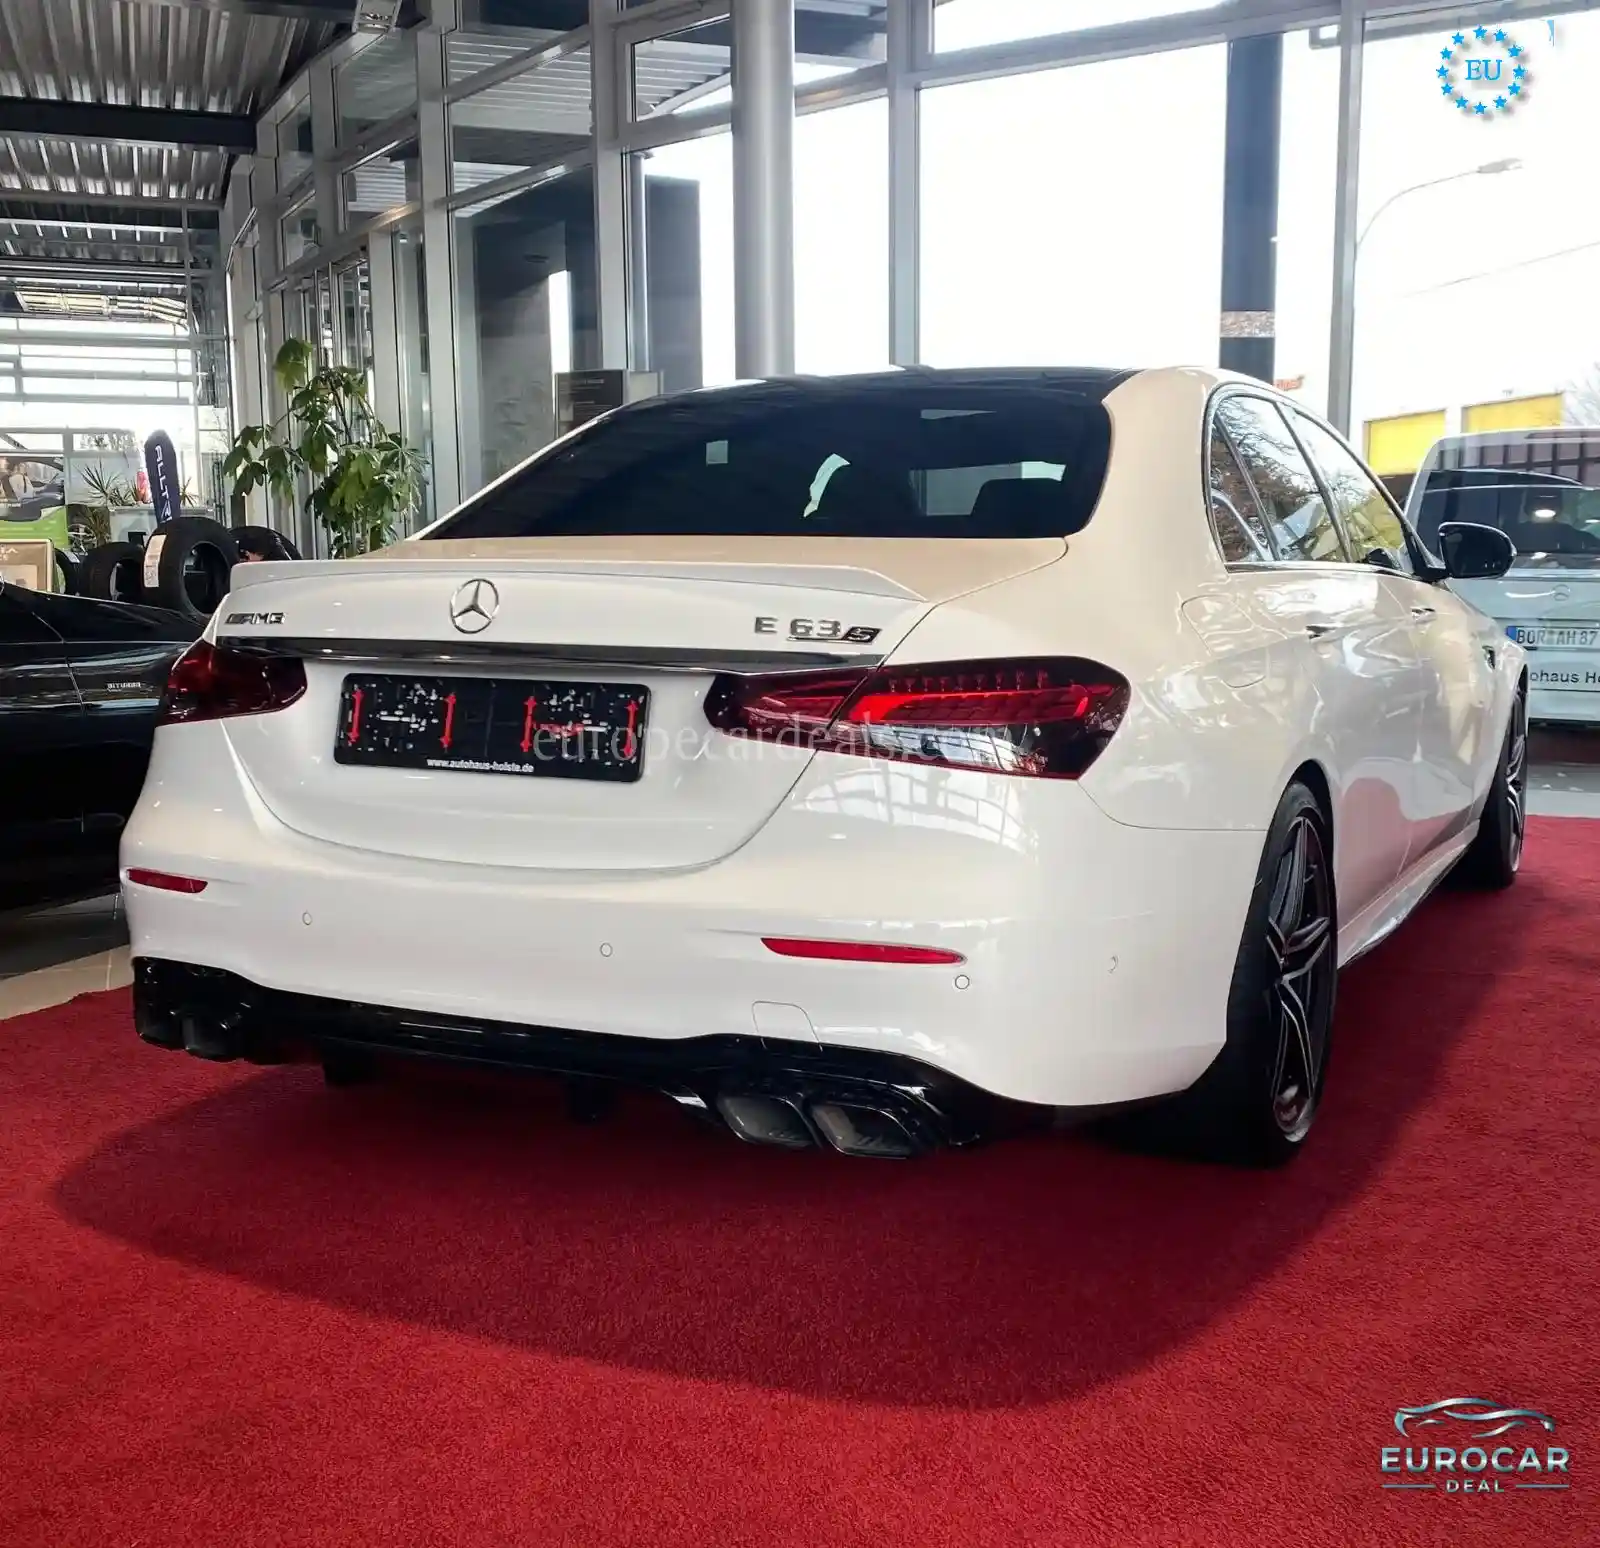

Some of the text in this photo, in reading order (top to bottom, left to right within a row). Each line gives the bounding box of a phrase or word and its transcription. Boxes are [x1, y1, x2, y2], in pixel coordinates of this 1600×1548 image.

[155, 445, 173, 524] ALLTR
[227, 612, 286, 625] AMG
[754, 617, 778, 634] E
[1529, 670, 1600, 684] ohaus H
[426, 758, 535, 773] www.autohaus-holste.de
